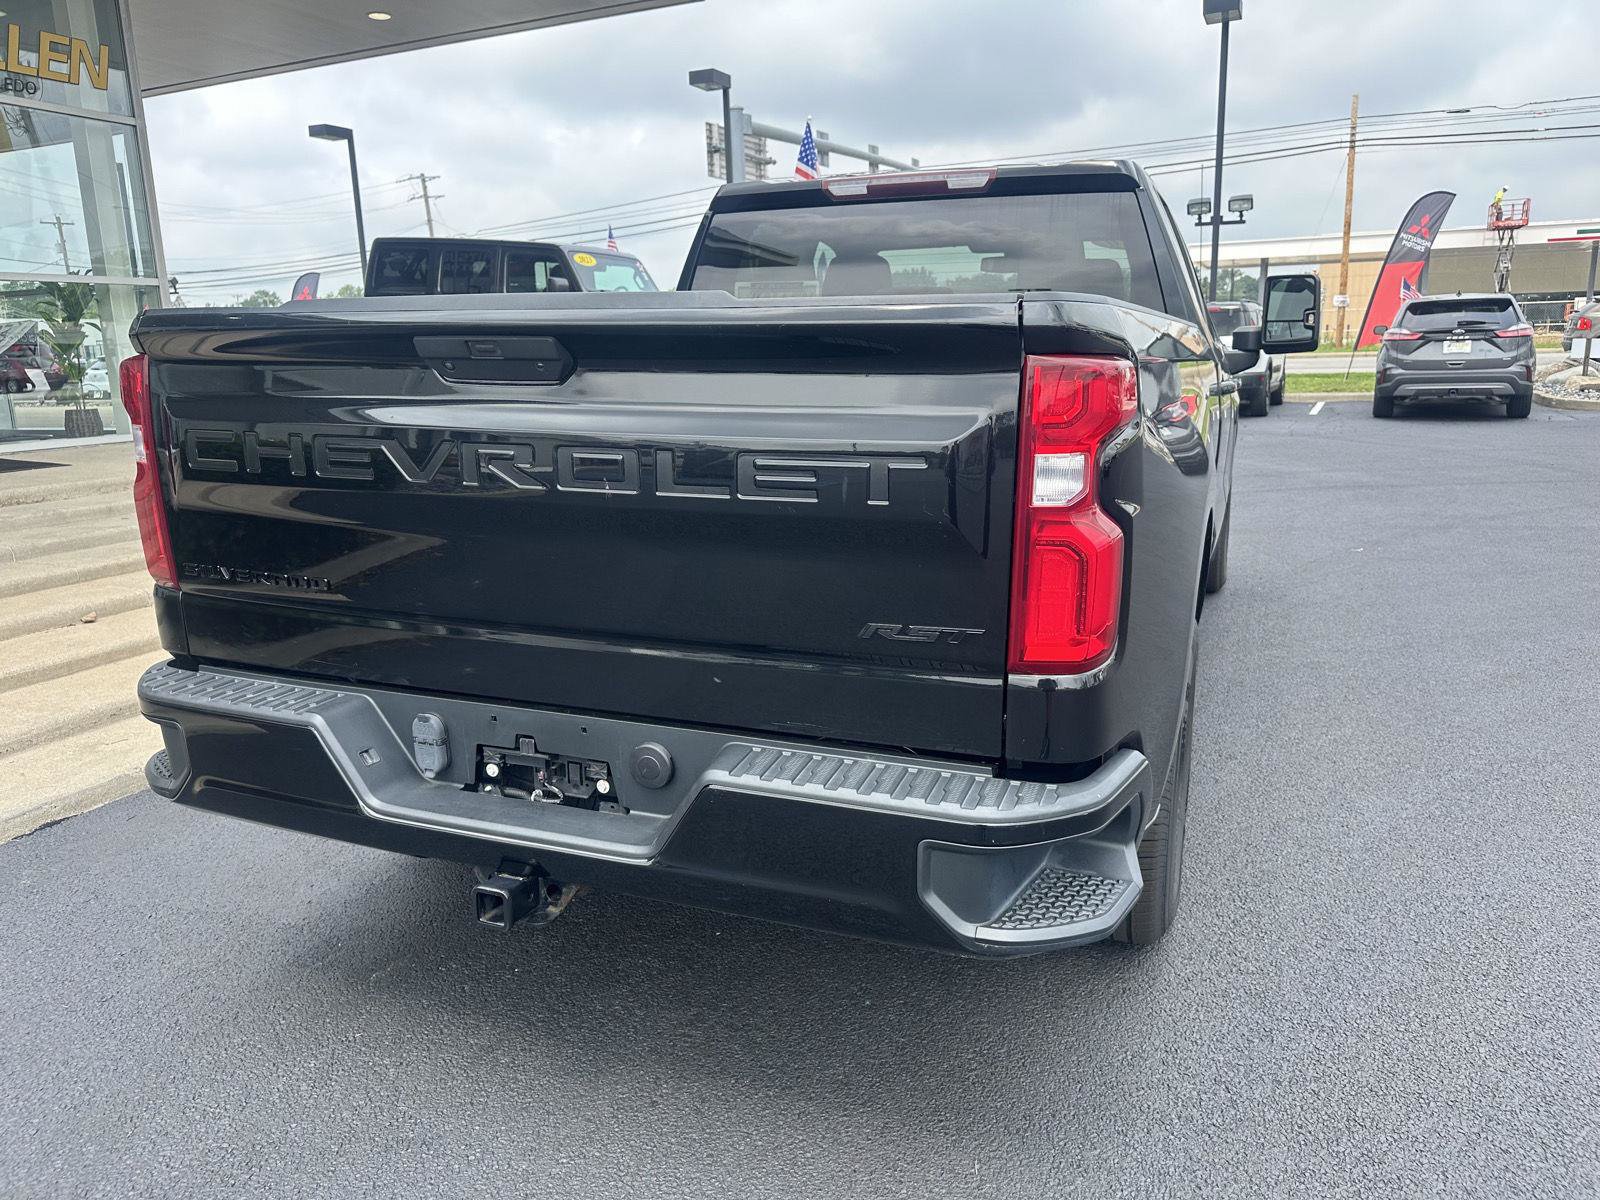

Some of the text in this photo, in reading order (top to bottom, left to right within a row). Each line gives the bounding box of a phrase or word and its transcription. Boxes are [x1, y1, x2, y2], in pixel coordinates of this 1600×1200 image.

[0, 23, 109, 90] LEN
[1401, 239, 1425, 252] MOTORS
[184, 428, 928, 505] CHEVROLET
[858, 622, 986, 644] RST
